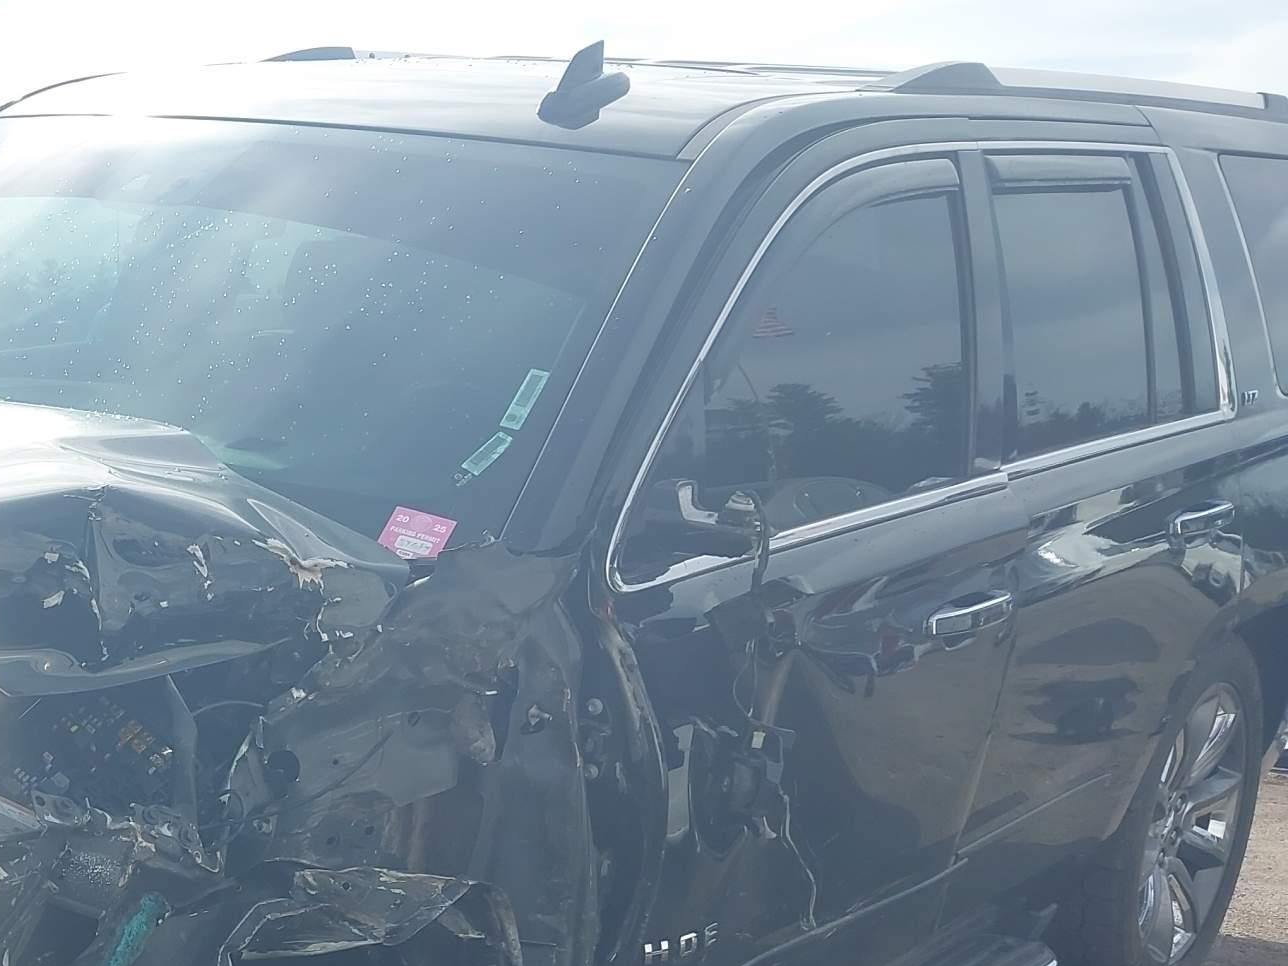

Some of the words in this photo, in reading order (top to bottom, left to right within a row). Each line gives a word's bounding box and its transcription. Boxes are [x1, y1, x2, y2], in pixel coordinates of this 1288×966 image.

[395, 514, 410, 523] 20
[432, 524, 447, 533] 25
[389, 525, 417, 537] PARKING
[416, 533, 441, 544] PERMIT
